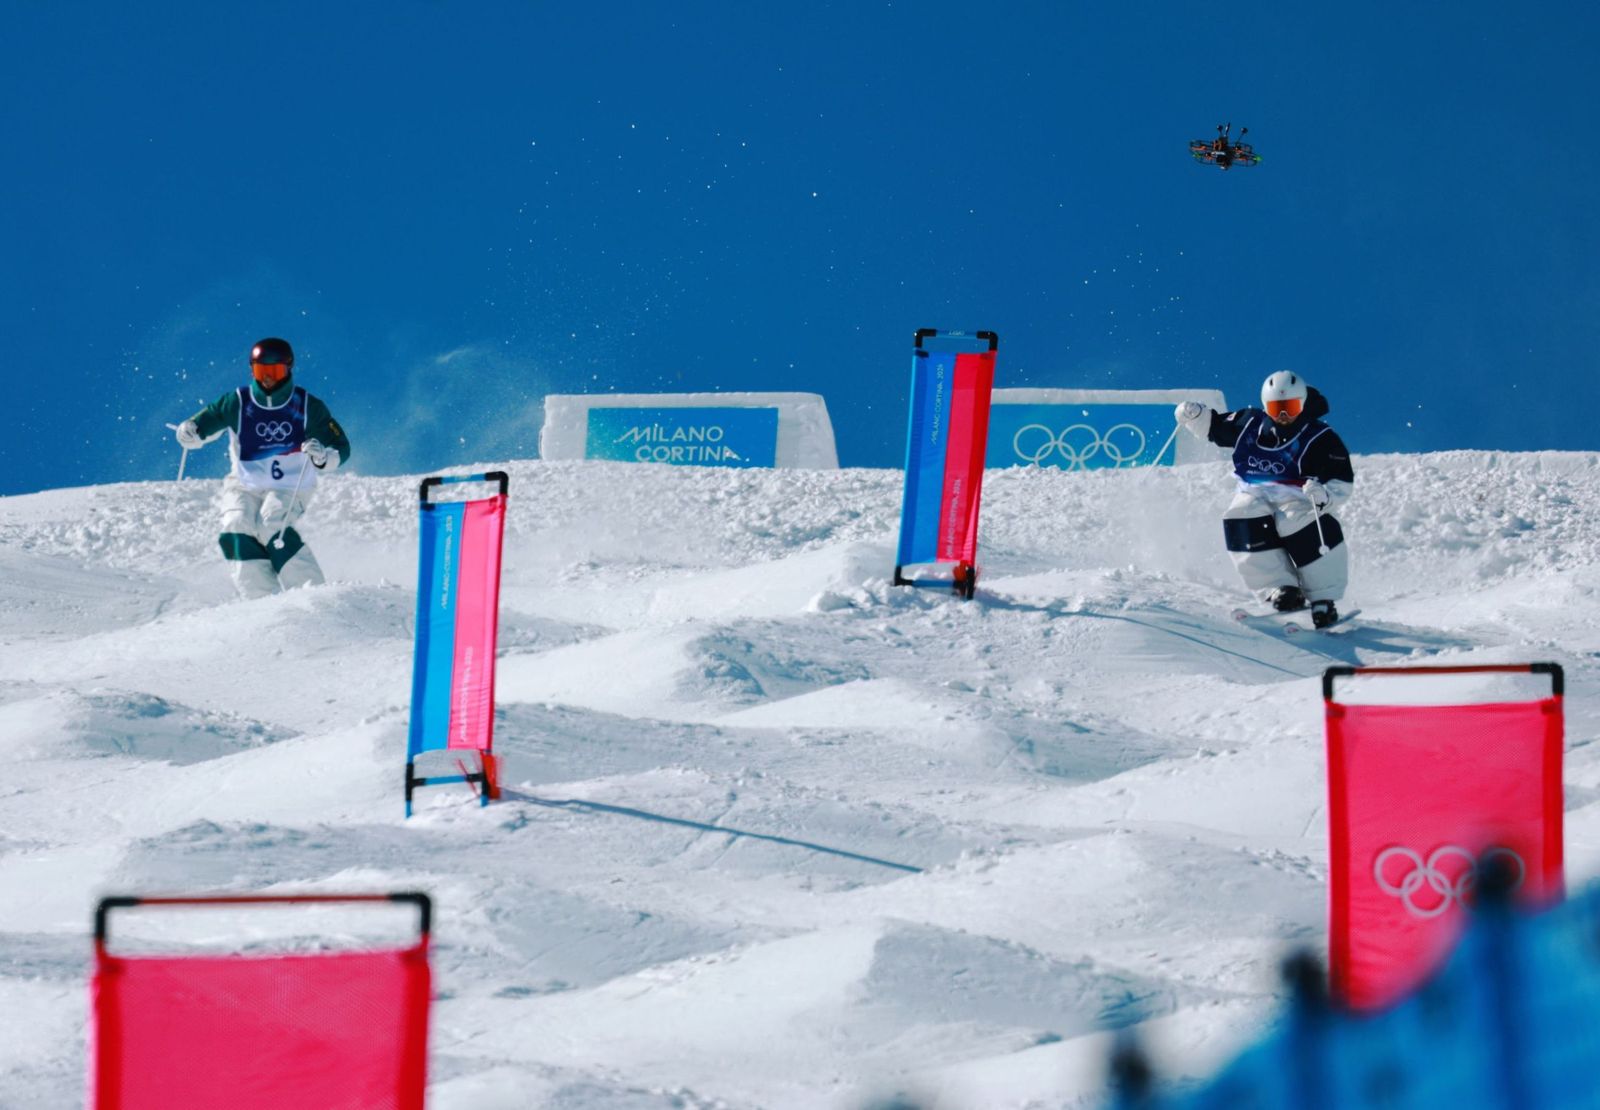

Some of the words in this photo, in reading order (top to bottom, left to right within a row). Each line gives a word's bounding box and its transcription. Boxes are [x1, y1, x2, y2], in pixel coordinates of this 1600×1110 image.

[614, 425, 724, 443] MILANO
[635, 445, 742, 463] CORTINA
[271, 460, 284, 481] 6
